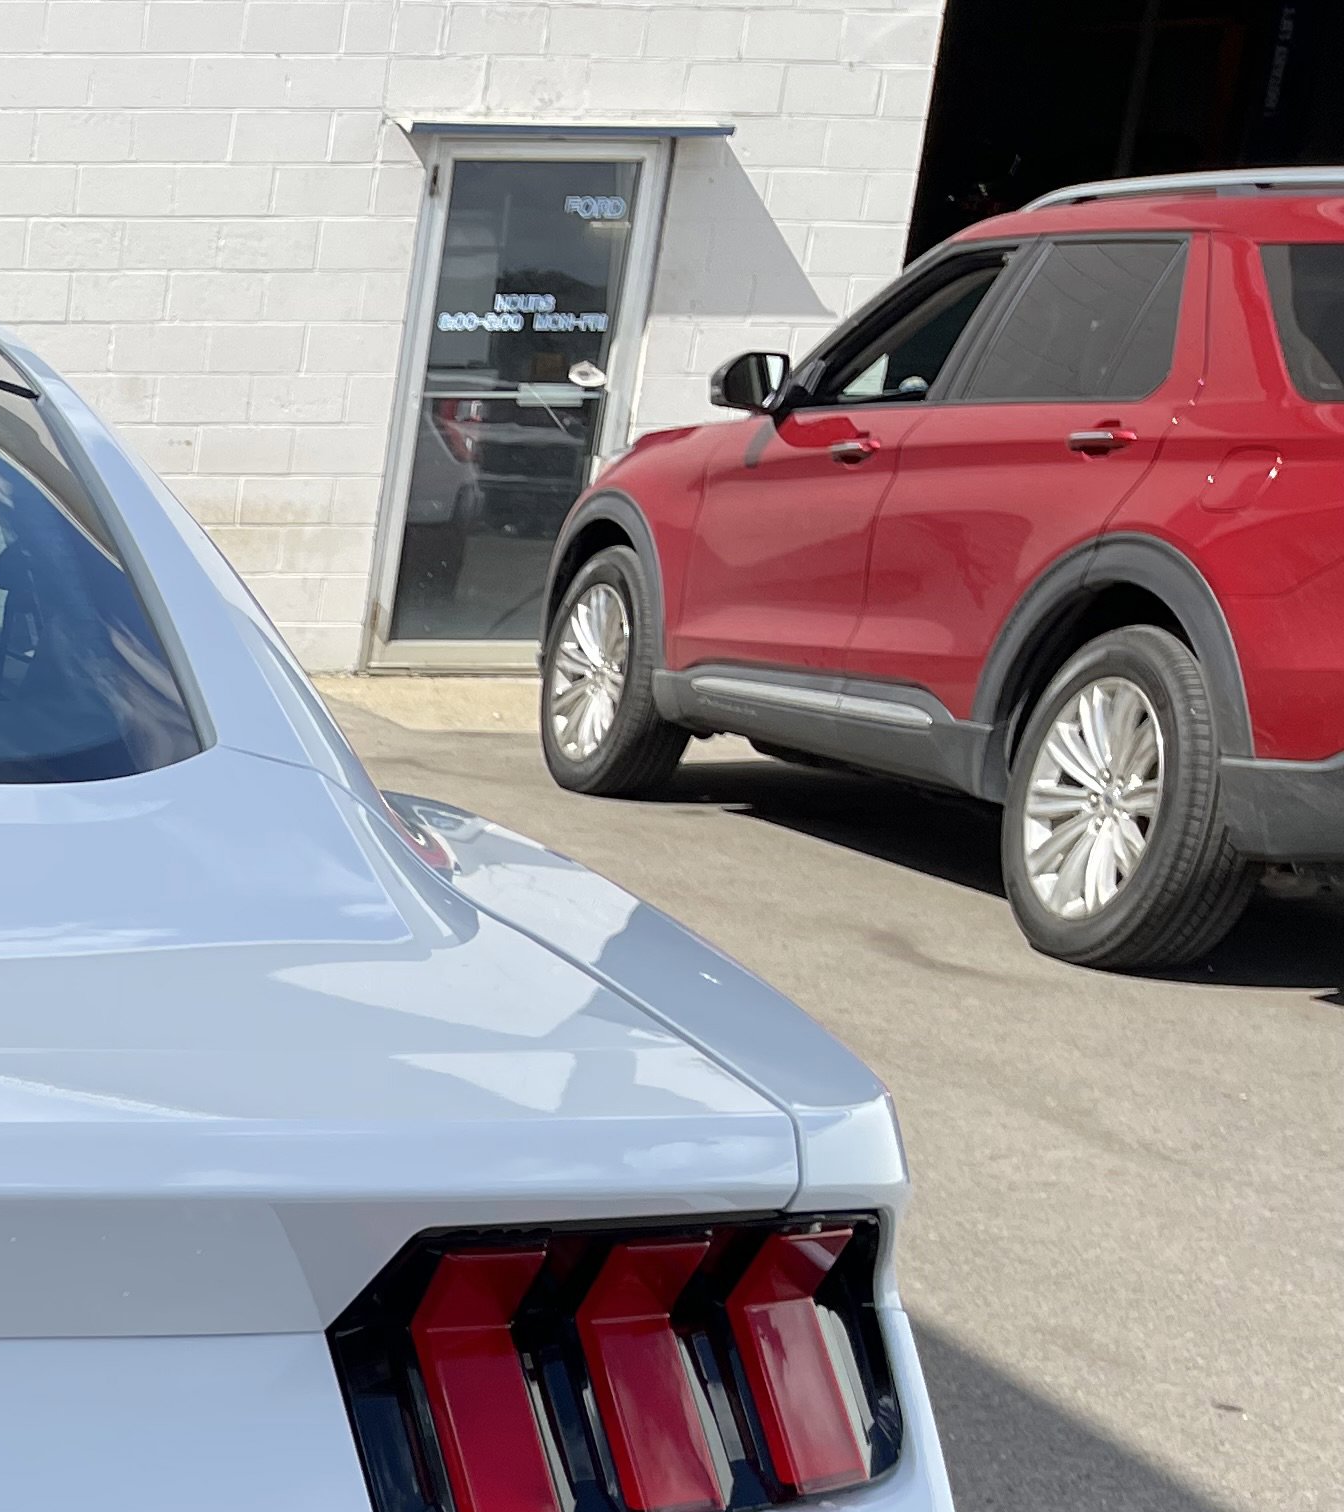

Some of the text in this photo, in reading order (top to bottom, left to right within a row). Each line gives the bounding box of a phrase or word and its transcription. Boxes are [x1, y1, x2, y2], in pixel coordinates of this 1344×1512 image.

[564, 195, 627, 219] FORD
[494, 293, 556, 312] HOURS
[532, 312, 609, 332] MON-FRI
